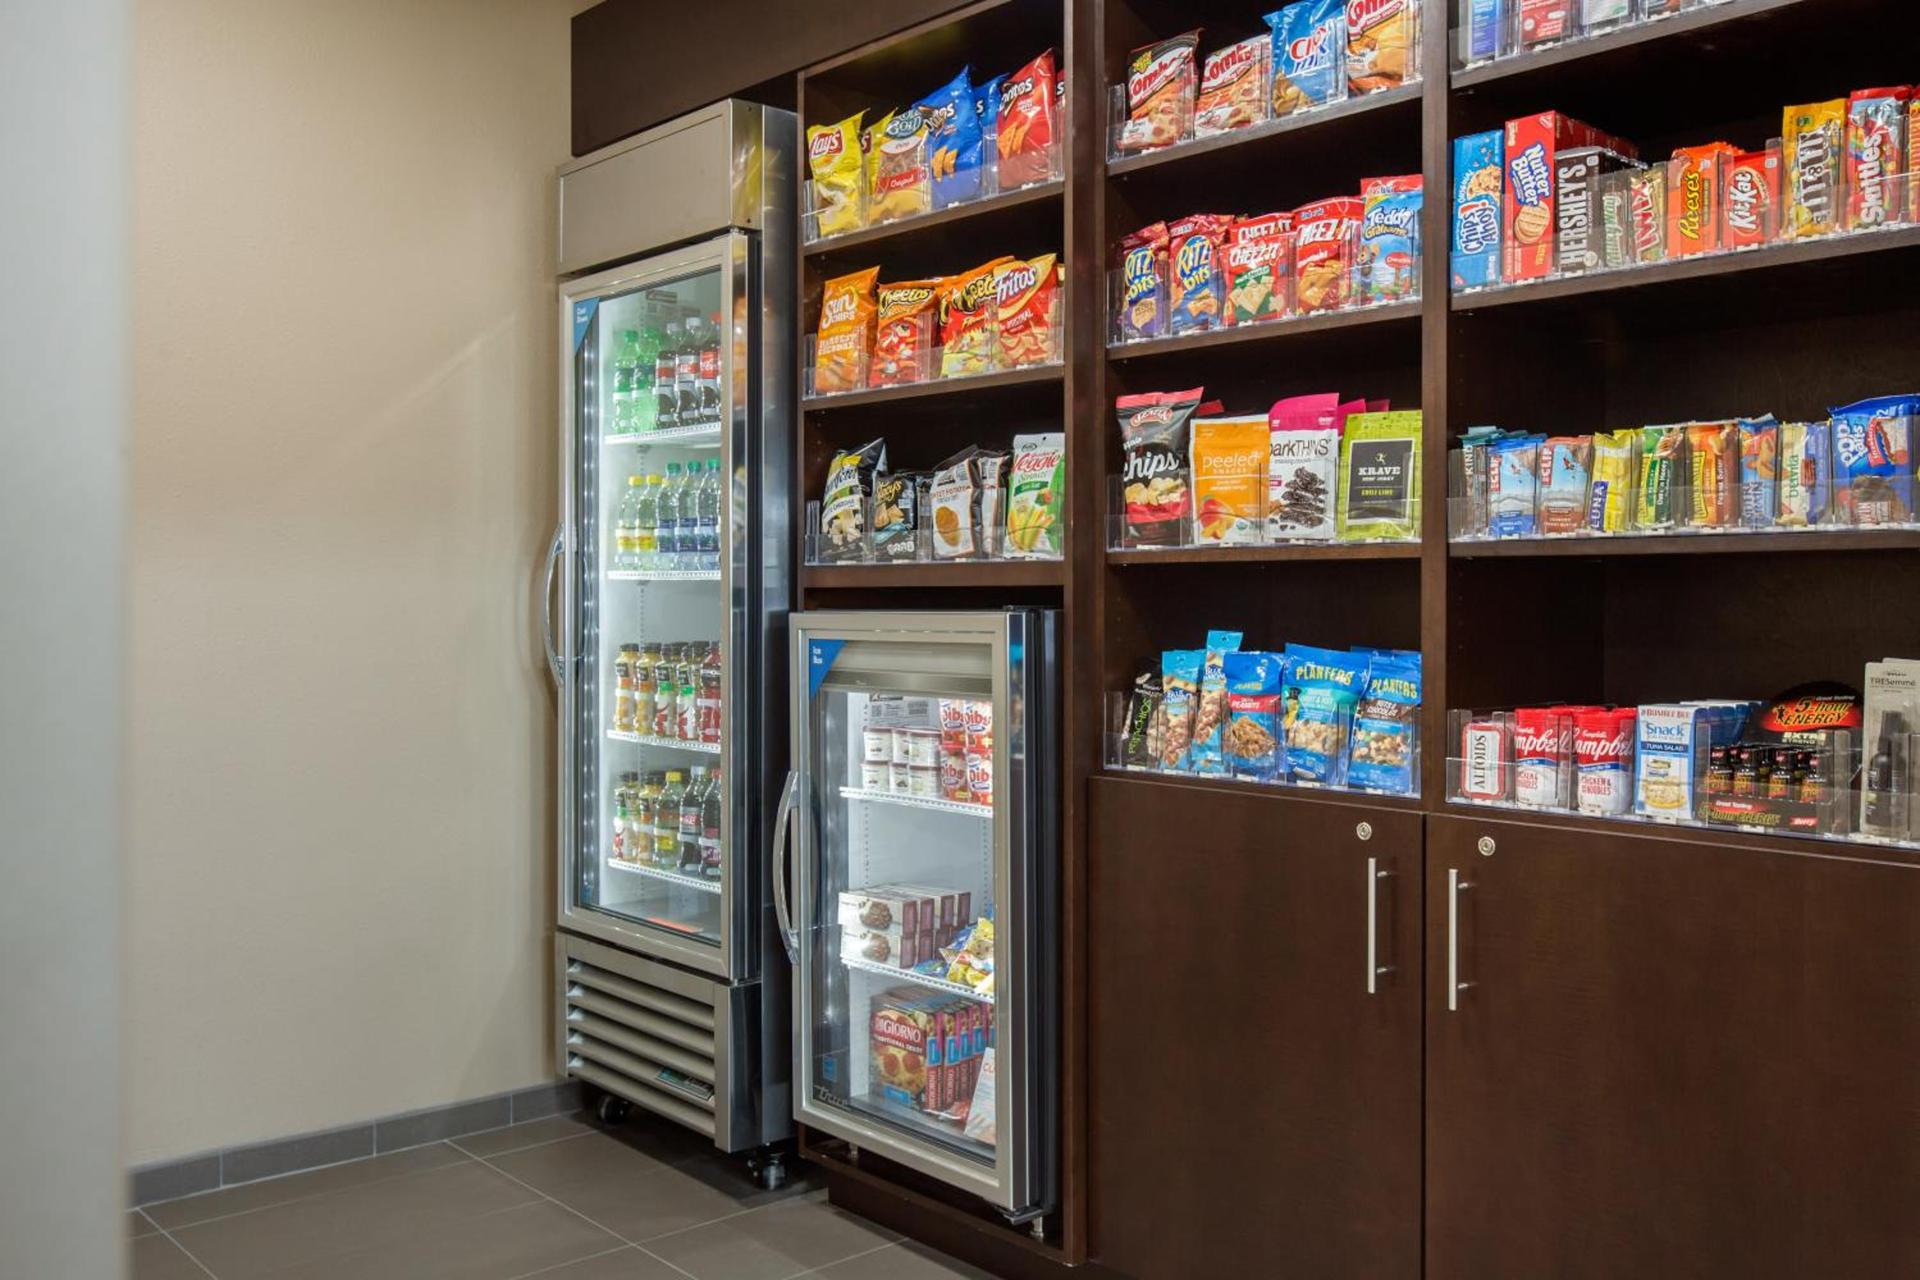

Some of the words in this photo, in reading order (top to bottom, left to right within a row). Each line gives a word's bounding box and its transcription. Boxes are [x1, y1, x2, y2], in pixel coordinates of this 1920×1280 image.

[1511, 157, 1538, 206] Butter
[1525, 144, 1550, 197] Nutter
[1859, 134, 1885, 222] Skittles
[1367, 208, 1412, 228] Teddy
[1463, 209, 1482, 253] Chips
[1559, 164, 1587, 266] HERSHEY'S
[1127, 251, 1154, 283] RITZ
[1178, 240, 1210, 275] RITZ
[879, 289, 930, 314] Cheetos
[996, 269, 1036, 304] Fritos
[1202, 453, 1258, 474] peeled
[1358, 466, 1400, 476] KRAVE
[1590, 485, 1605, 529] LUNA
[1296, 665, 1355, 686] PLANTERS
[1371, 678, 1418, 699] PLANTERS
[1647, 722, 1685, 736] Snack
[1784, 713, 1846, 725] ENERGY
[1473, 735, 1486, 789] ALTOIDS
